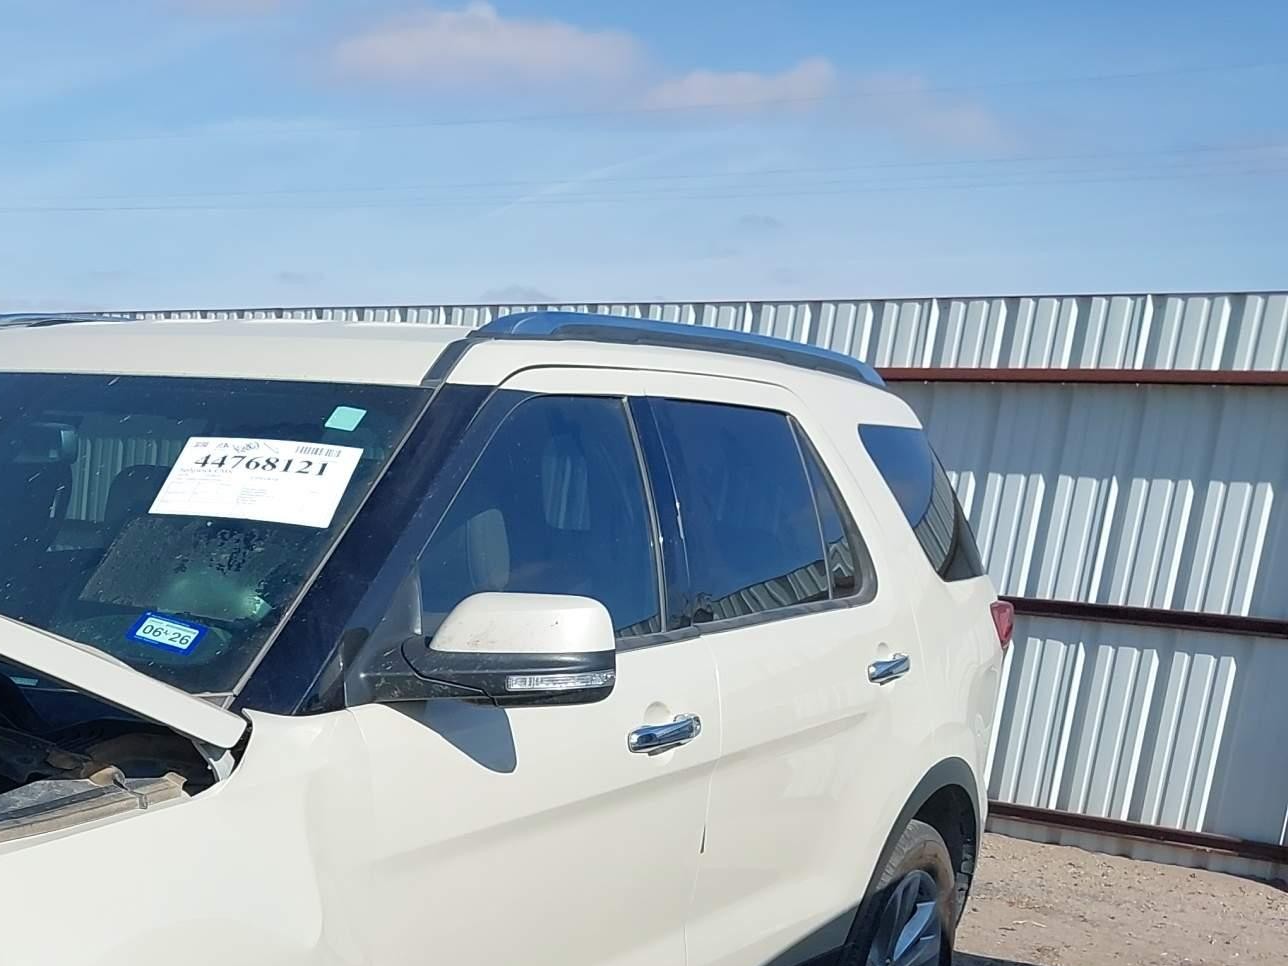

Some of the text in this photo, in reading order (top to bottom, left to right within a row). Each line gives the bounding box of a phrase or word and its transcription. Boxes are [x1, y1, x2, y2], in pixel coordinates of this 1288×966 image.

[194, 453, 329, 477] 44768121
[142, 624, 192, 646] 06 26
